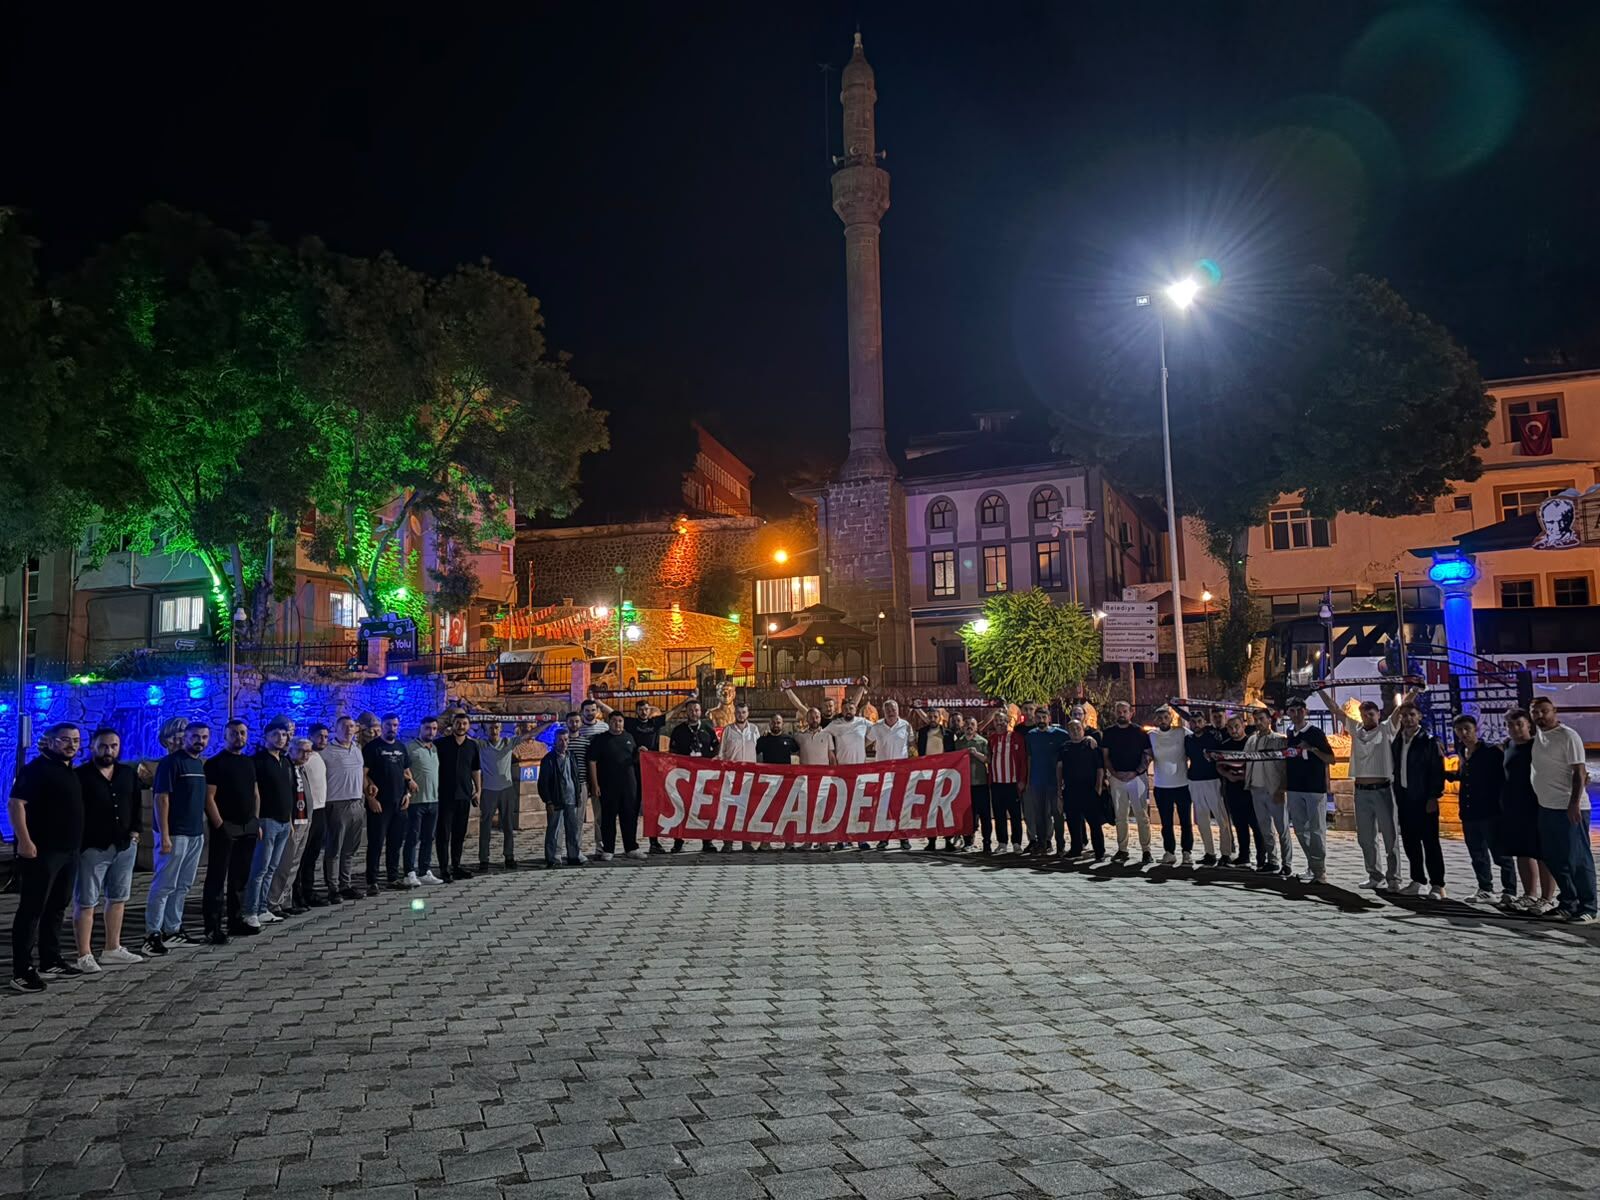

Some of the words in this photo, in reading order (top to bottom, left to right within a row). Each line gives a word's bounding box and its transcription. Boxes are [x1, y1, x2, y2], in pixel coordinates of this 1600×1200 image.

[395, 640, 411, 648] Yolu
[965, 699, 988, 707] KOL
[657, 767, 962, 835] ŞEHZADELER
